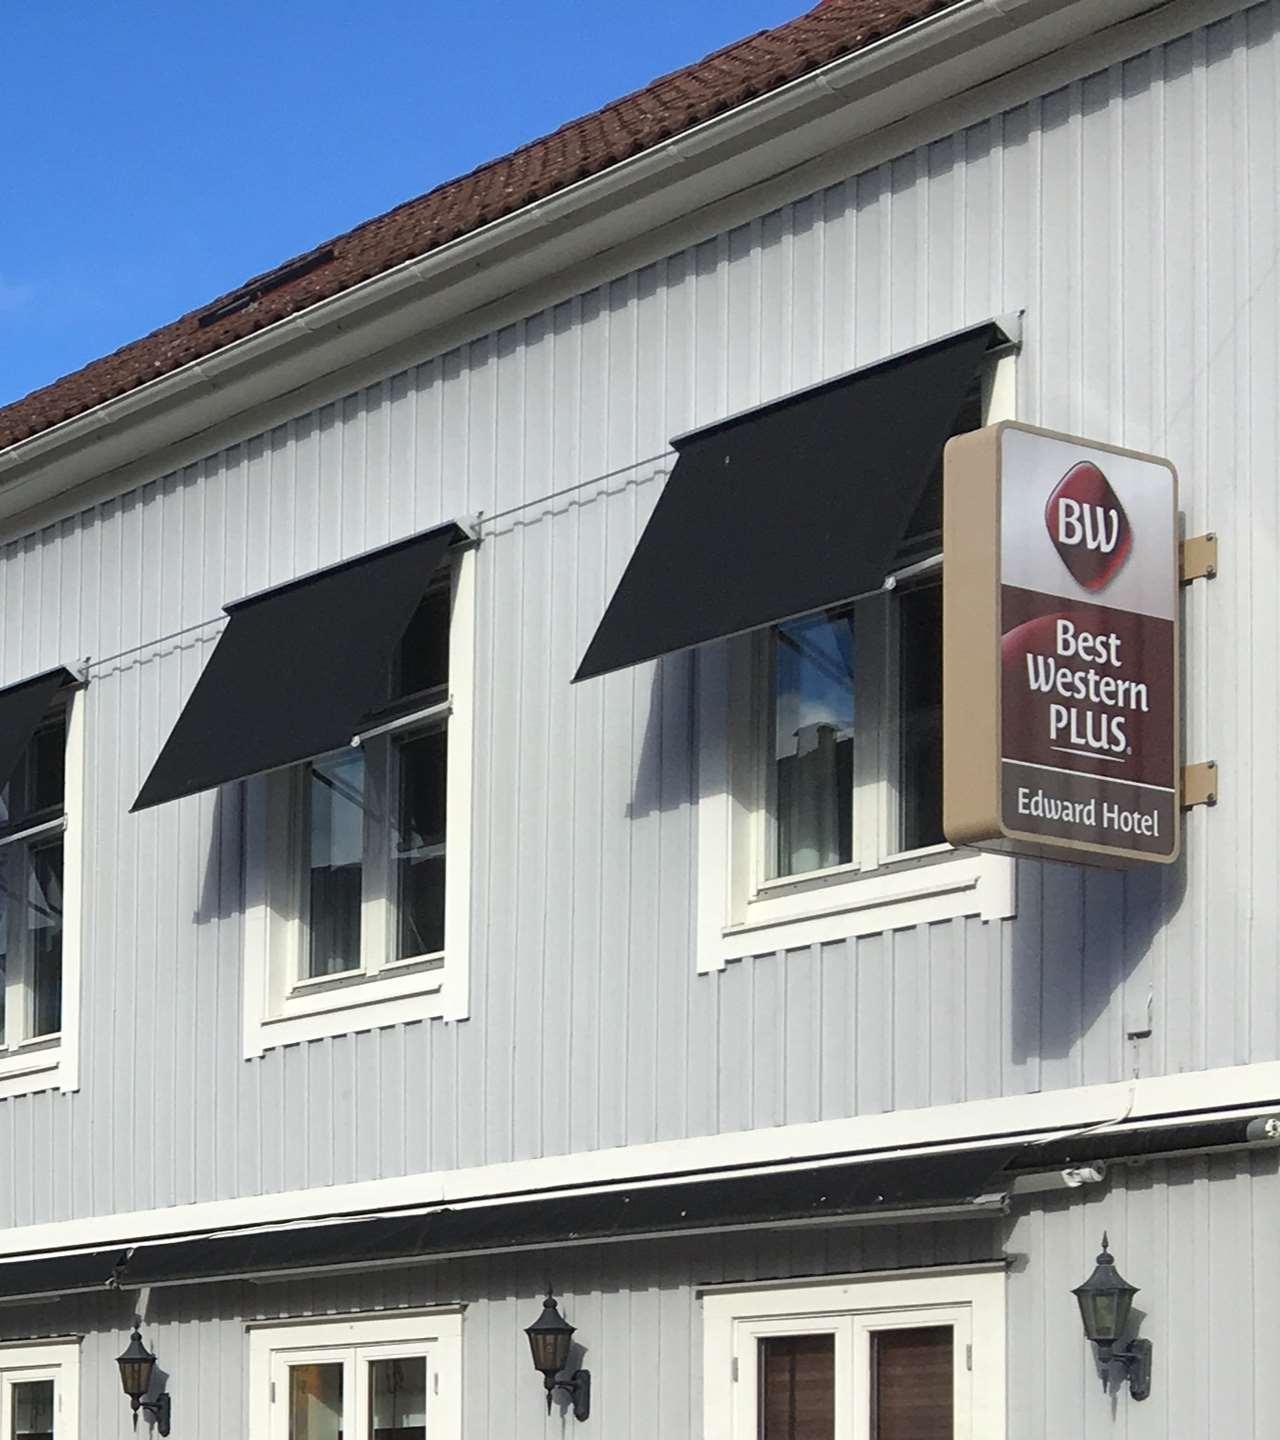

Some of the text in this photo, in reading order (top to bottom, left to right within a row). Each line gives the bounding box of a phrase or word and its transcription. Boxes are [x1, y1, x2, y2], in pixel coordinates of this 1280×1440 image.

[1058, 497, 1119, 553] BW
[1056, 618, 1122, 668] Best
[1025, 652, 1150, 713] Western
[1049, 703, 1128, 755] PLUS
[1017, 786, 1160, 838] Edward Hotel
